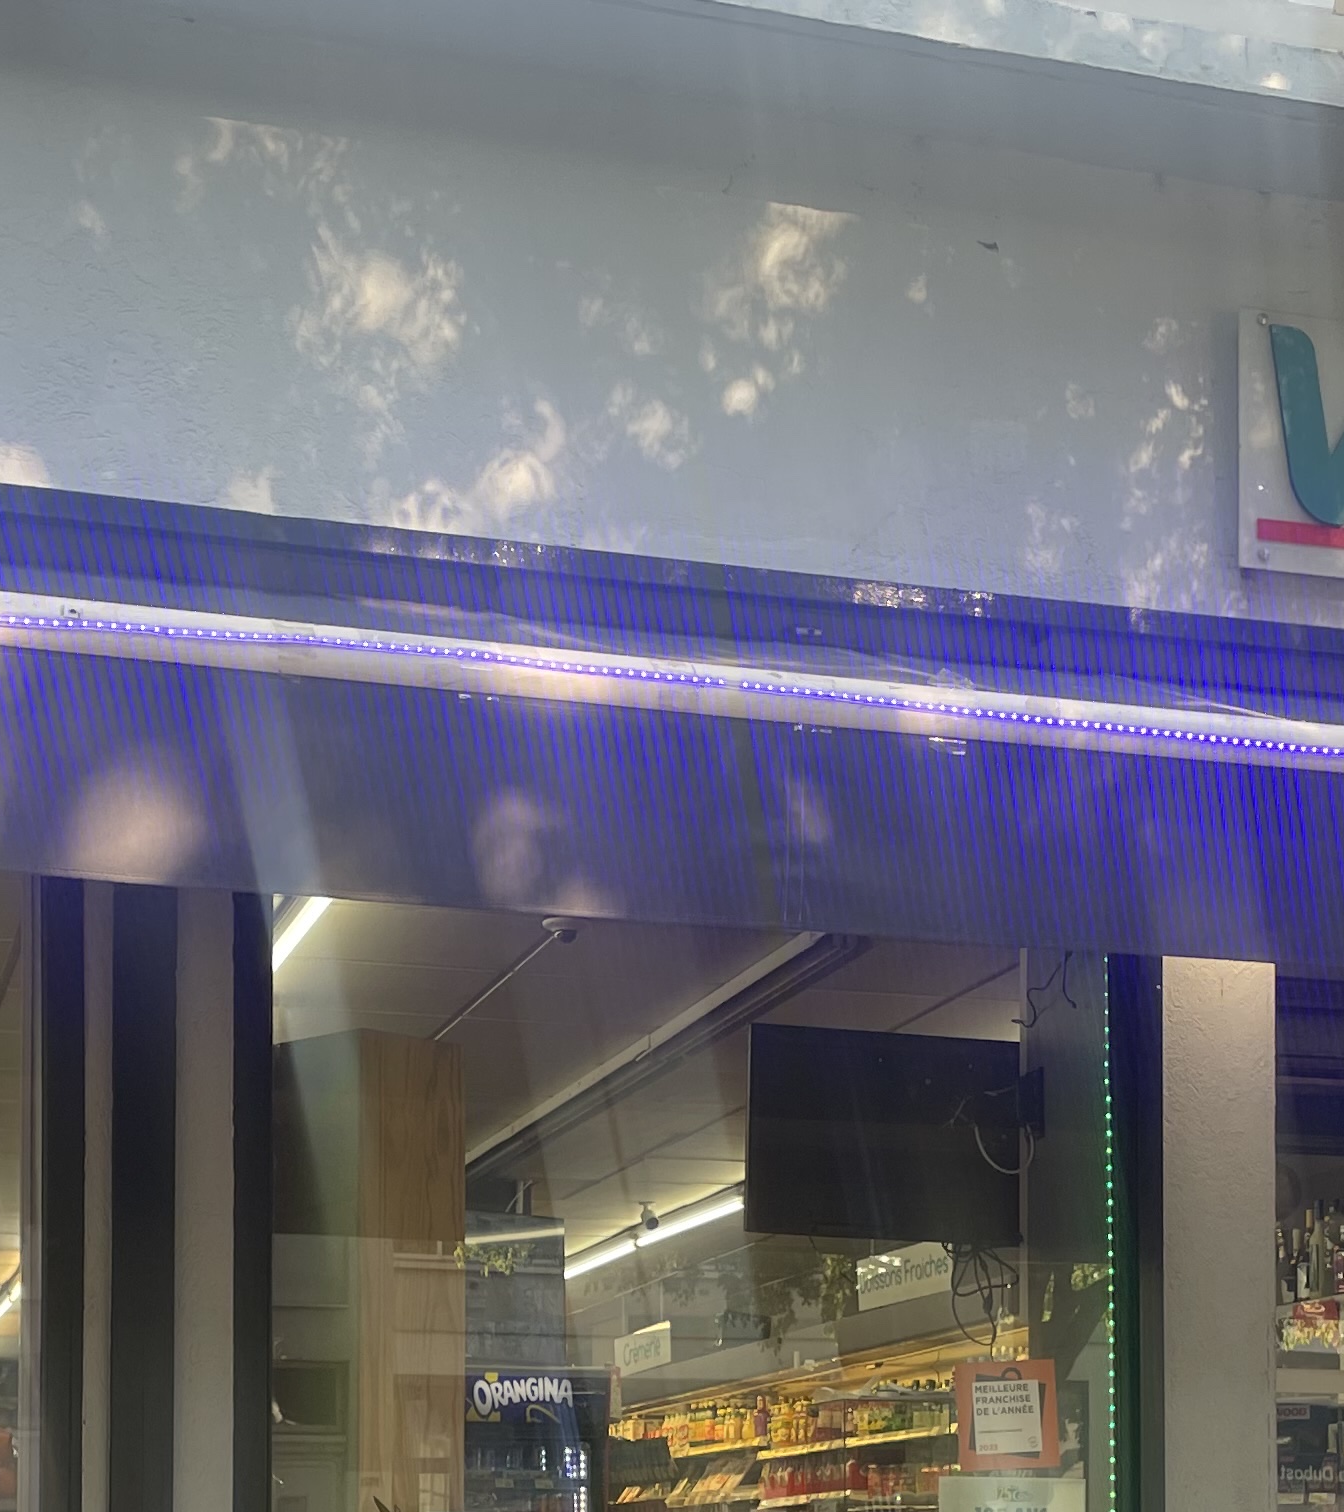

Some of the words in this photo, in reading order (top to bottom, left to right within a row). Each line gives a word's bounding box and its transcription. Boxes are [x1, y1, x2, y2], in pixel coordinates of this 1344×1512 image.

[974, 1383, 1029, 1393] MEILLEURE
[975, 1394, 1031, 1405] FRANCHISE
[976, 1407, 990, 1416] DE
[992, 1404, 1035, 1415] L'ANNÉE
